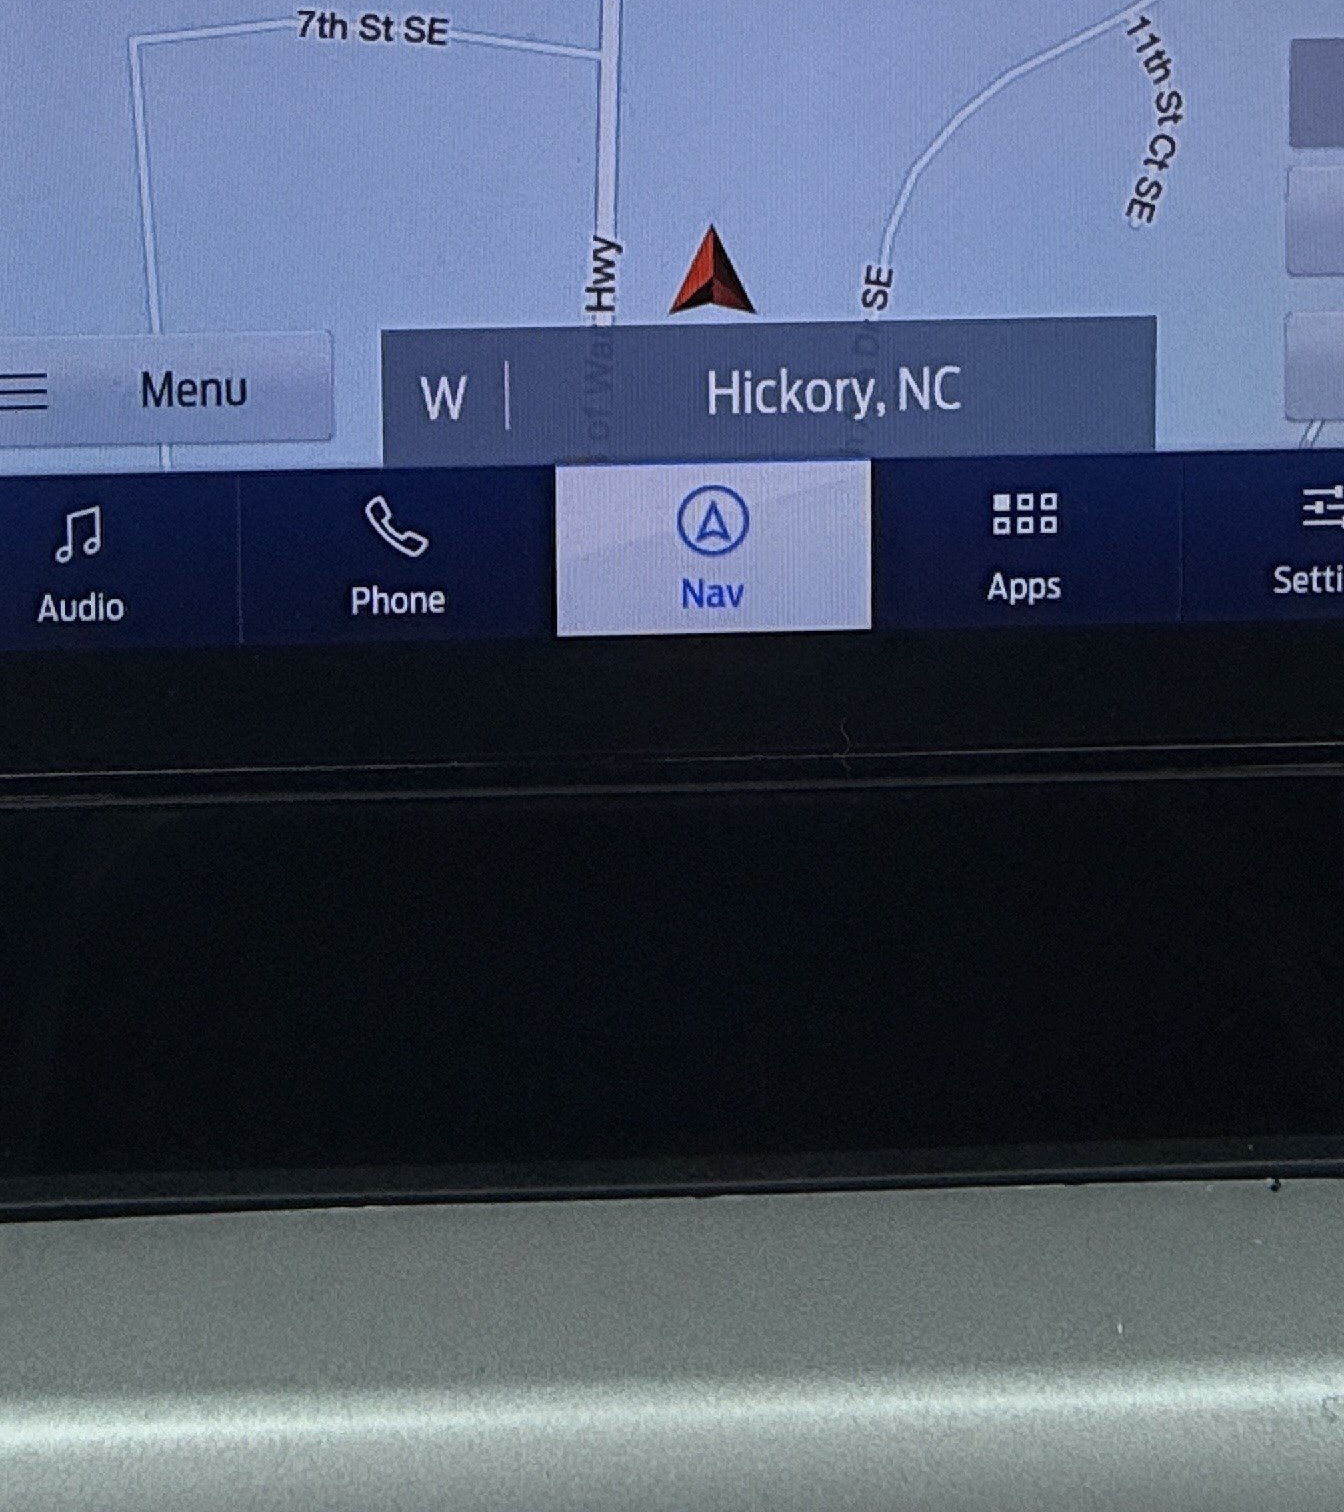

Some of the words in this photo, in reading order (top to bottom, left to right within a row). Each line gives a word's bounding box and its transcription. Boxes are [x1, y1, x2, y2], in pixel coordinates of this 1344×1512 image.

[297, 10, 348, 40] 7th
[358, 13, 394, 42] St
[404, 15, 450, 46] SE
[1126, 15, 1173, 85] 11th
[1156, 90, 1184, 126] St
[1143, 134, 1176, 171] Ct
[1125, 176, 1163, 224] SE
[584, 235, 623, 312] Hwy
[861, 264, 894, 311] SE
[141, 370, 247, 409] Menu
[420, 375, 468, 421] W
[708, 367, 886, 421] Hickory,
[899, 365, 961, 411] NC
[351, 584, 446, 615] Phone
[682, 578, 745, 609] Nav
[987, 571, 1062, 604] Apps
[37, 591, 125, 623] Audio
